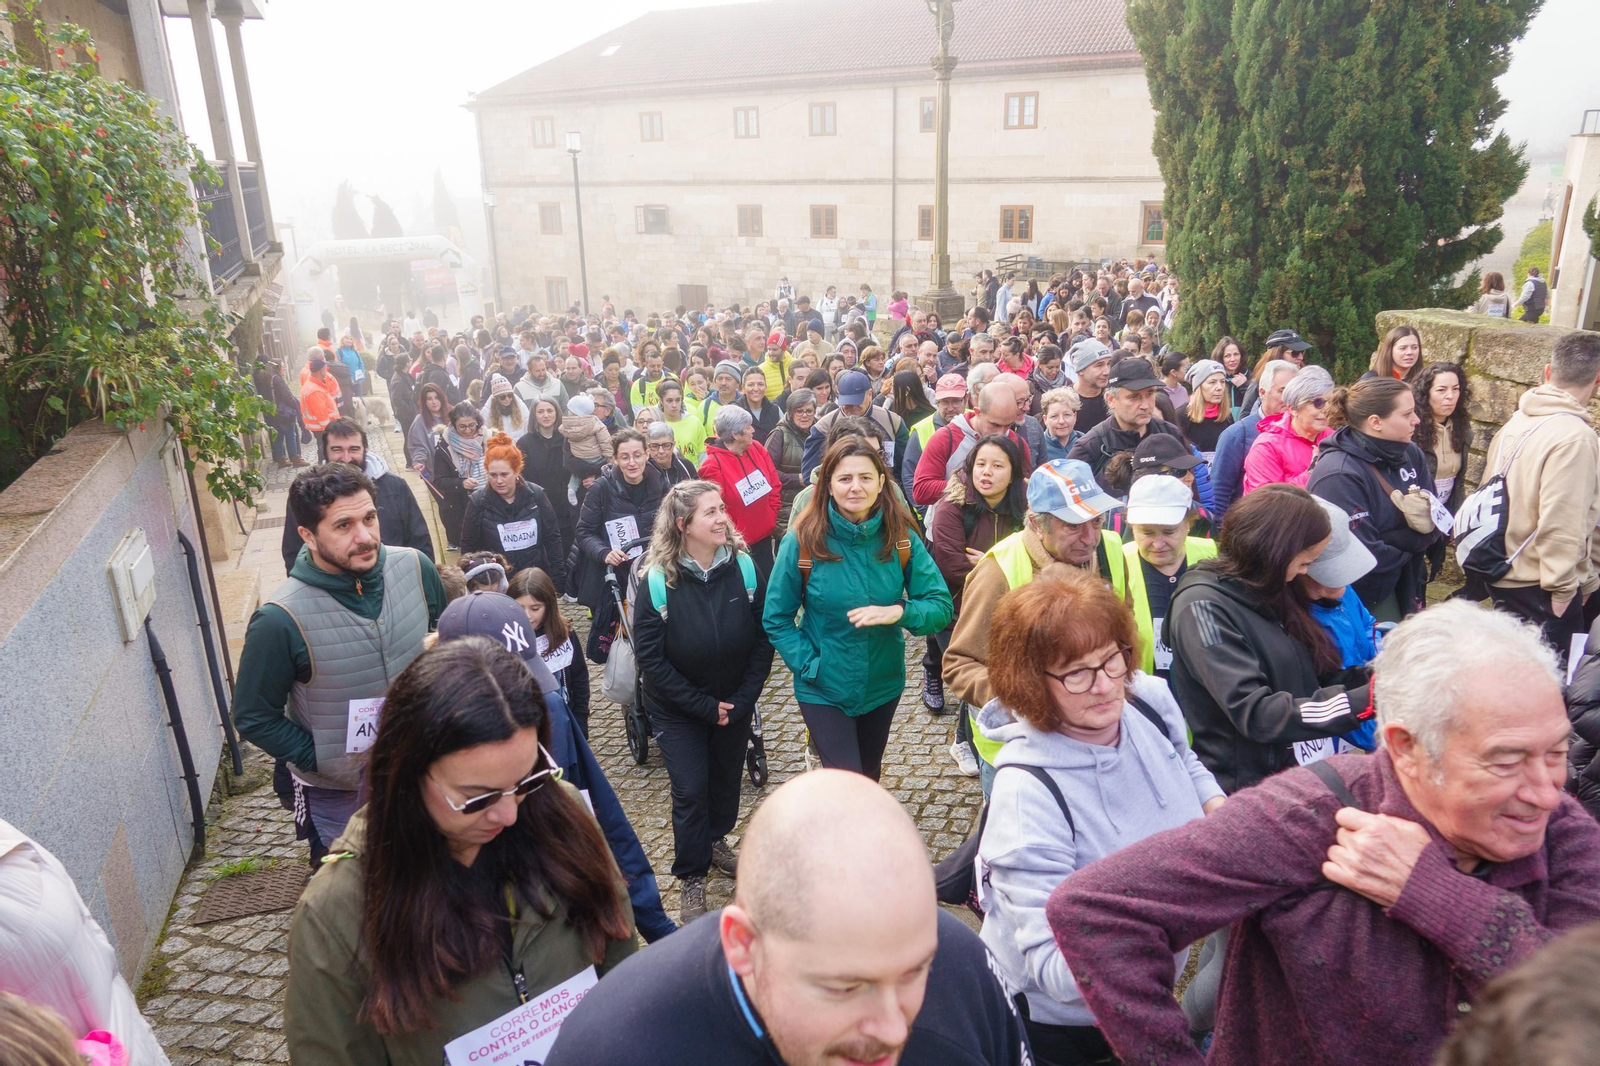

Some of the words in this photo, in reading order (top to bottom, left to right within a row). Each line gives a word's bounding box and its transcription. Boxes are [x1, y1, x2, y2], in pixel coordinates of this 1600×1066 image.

[326, 247, 359, 256] HOTEL
[365, 246, 377, 254] LA
[503, 530, 536, 542] ANDAINA
[501, 621, 530, 652] NY
[541, 642, 572, 662] DAINA
[356, 722, 378, 737] AN
[490, 989, 570, 1039] CORREMOS
[469, 1027, 527, 1062] CONTRA
[529, 1020, 539, 1030] O
[512, 1045, 520, 1053] 22
[522, 1038, 531, 1047] DE
